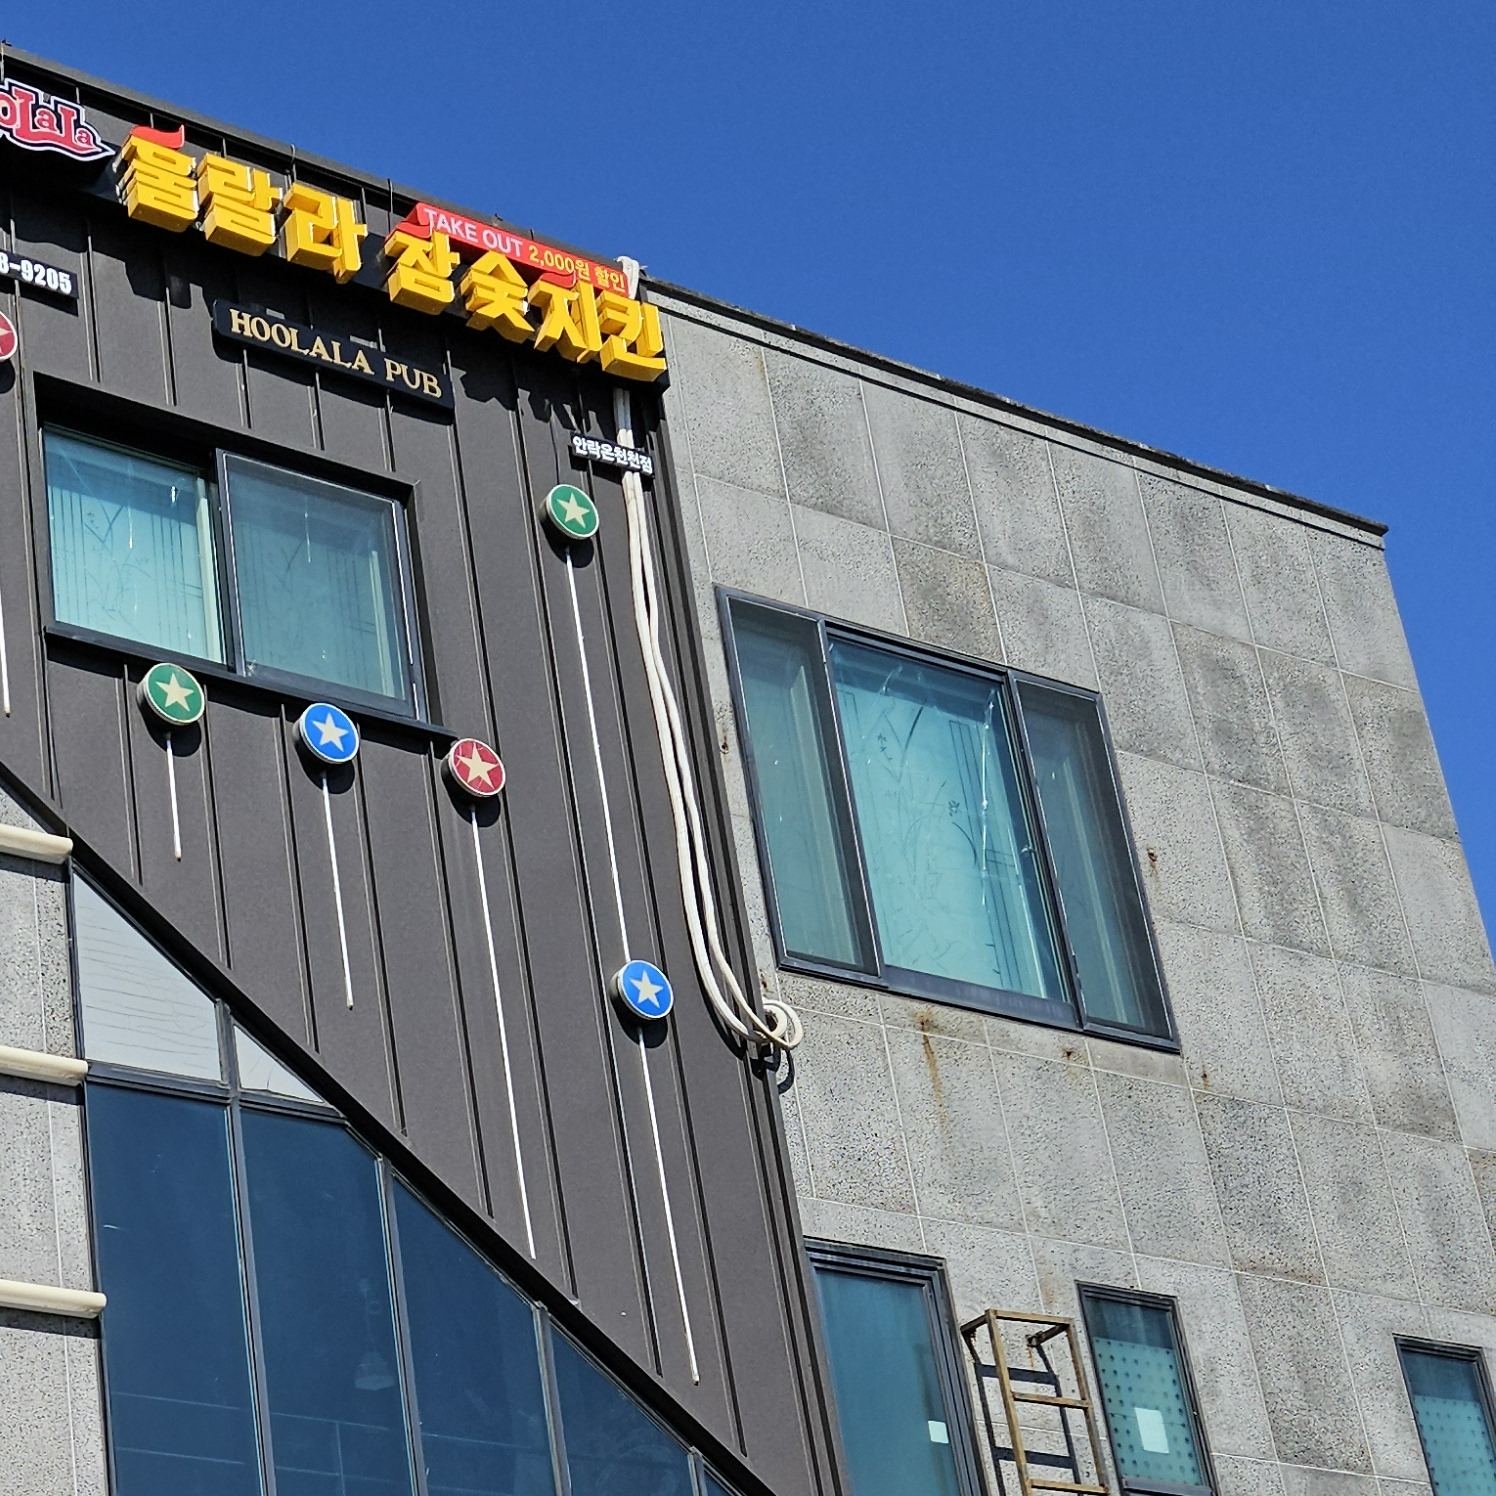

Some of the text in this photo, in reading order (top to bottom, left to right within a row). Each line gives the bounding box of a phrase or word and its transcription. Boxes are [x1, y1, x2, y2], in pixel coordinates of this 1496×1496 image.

[118, 125, 667, 382] 훌랄라 참숯치킨
[424, 208, 625, 293] TAKE OUT 2,000원 할인
[229, 308, 442, 399] HOOLALA PUB
[572, 435, 653, 474] 안락온천천점
